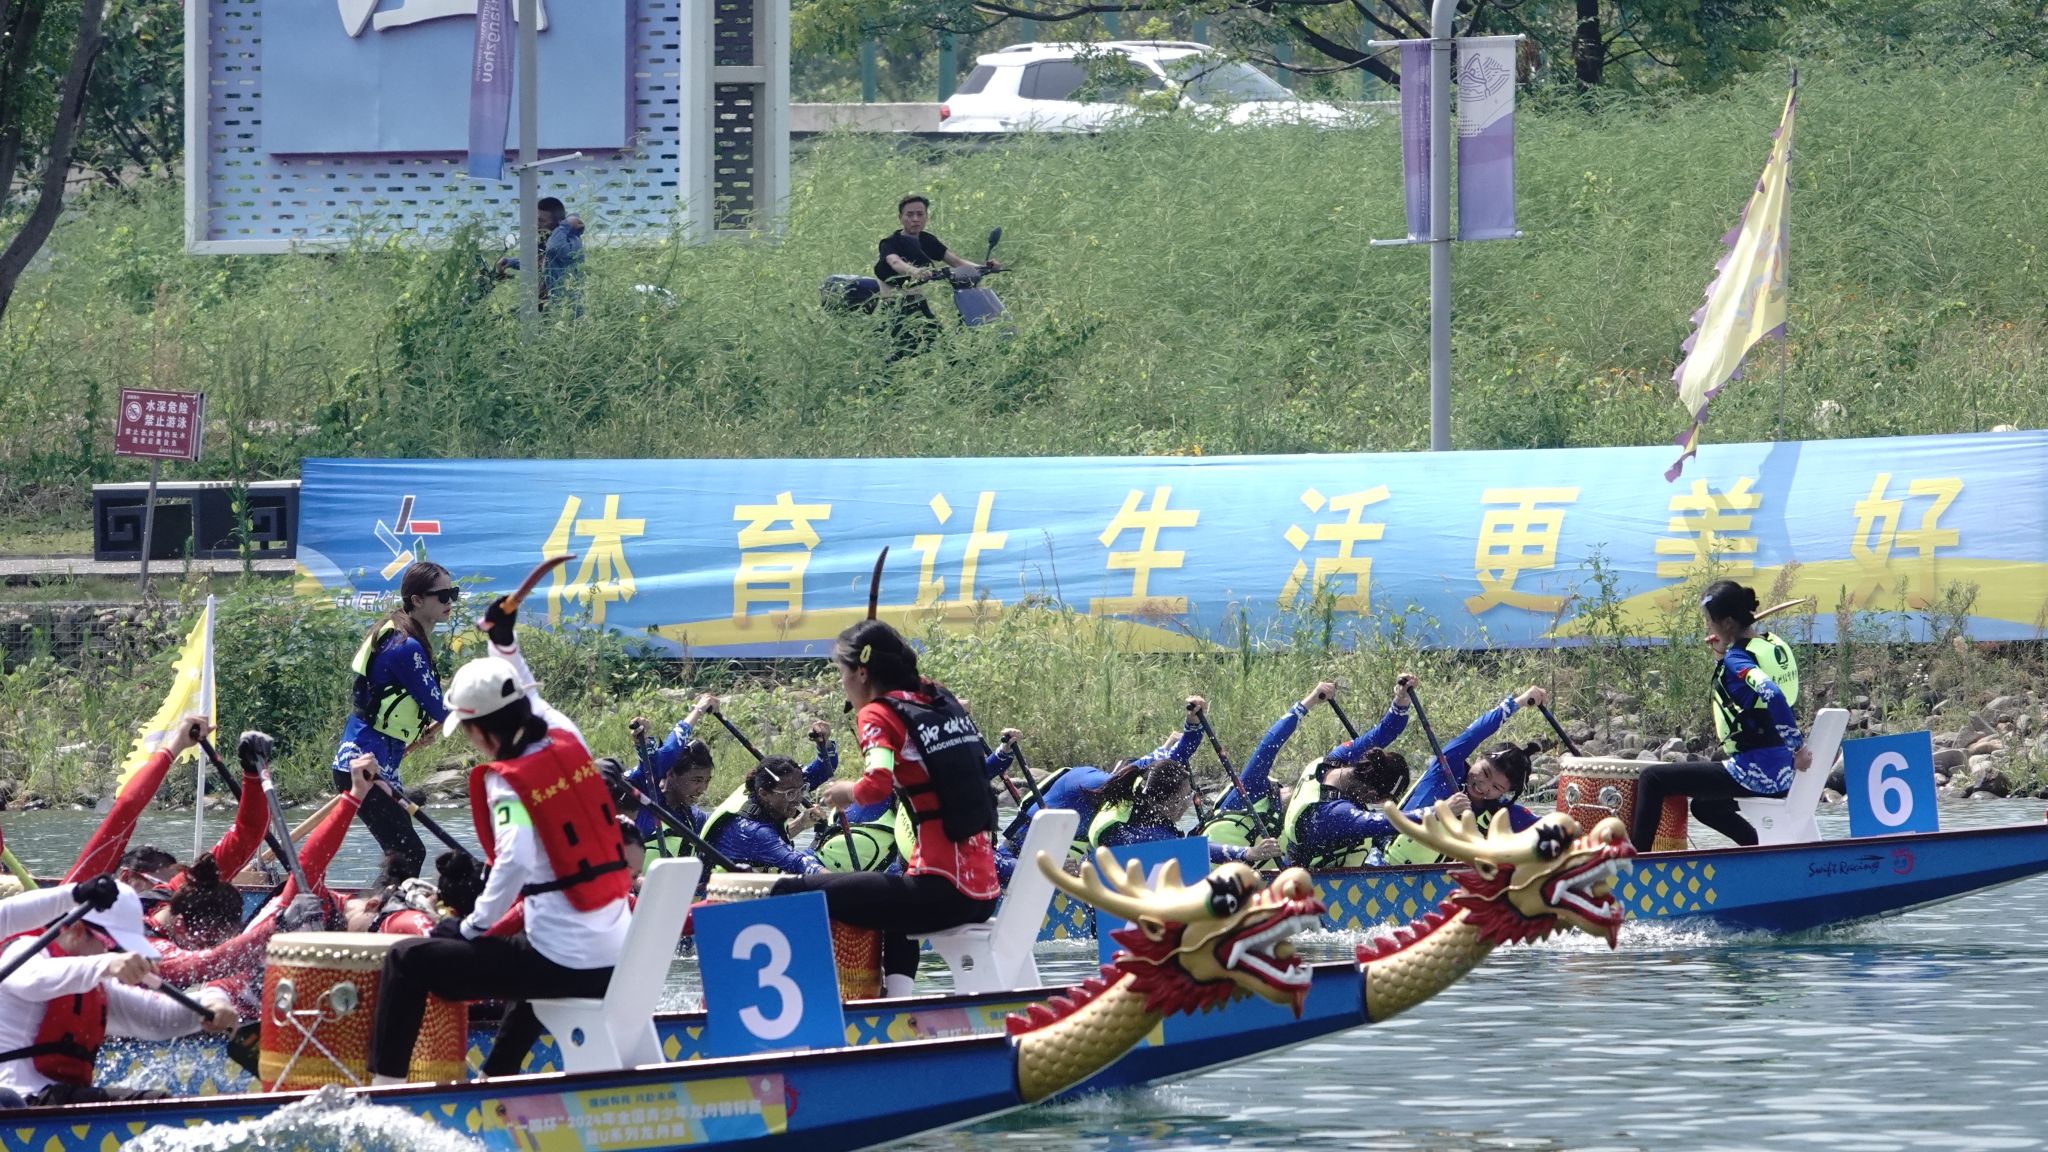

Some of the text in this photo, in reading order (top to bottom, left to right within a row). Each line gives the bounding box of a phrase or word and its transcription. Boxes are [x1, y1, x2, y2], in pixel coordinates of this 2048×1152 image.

[144, 414, 187, 429] 禁止游泳
[145, 400, 189, 414] 水深危险
[541, 472, 1964, 628] 体育让生活更美好
[1868, 751, 1914, 827] 6
[1808, 861, 1880, 878] Swift Racing
[731, 923, 804, 1041] 3
